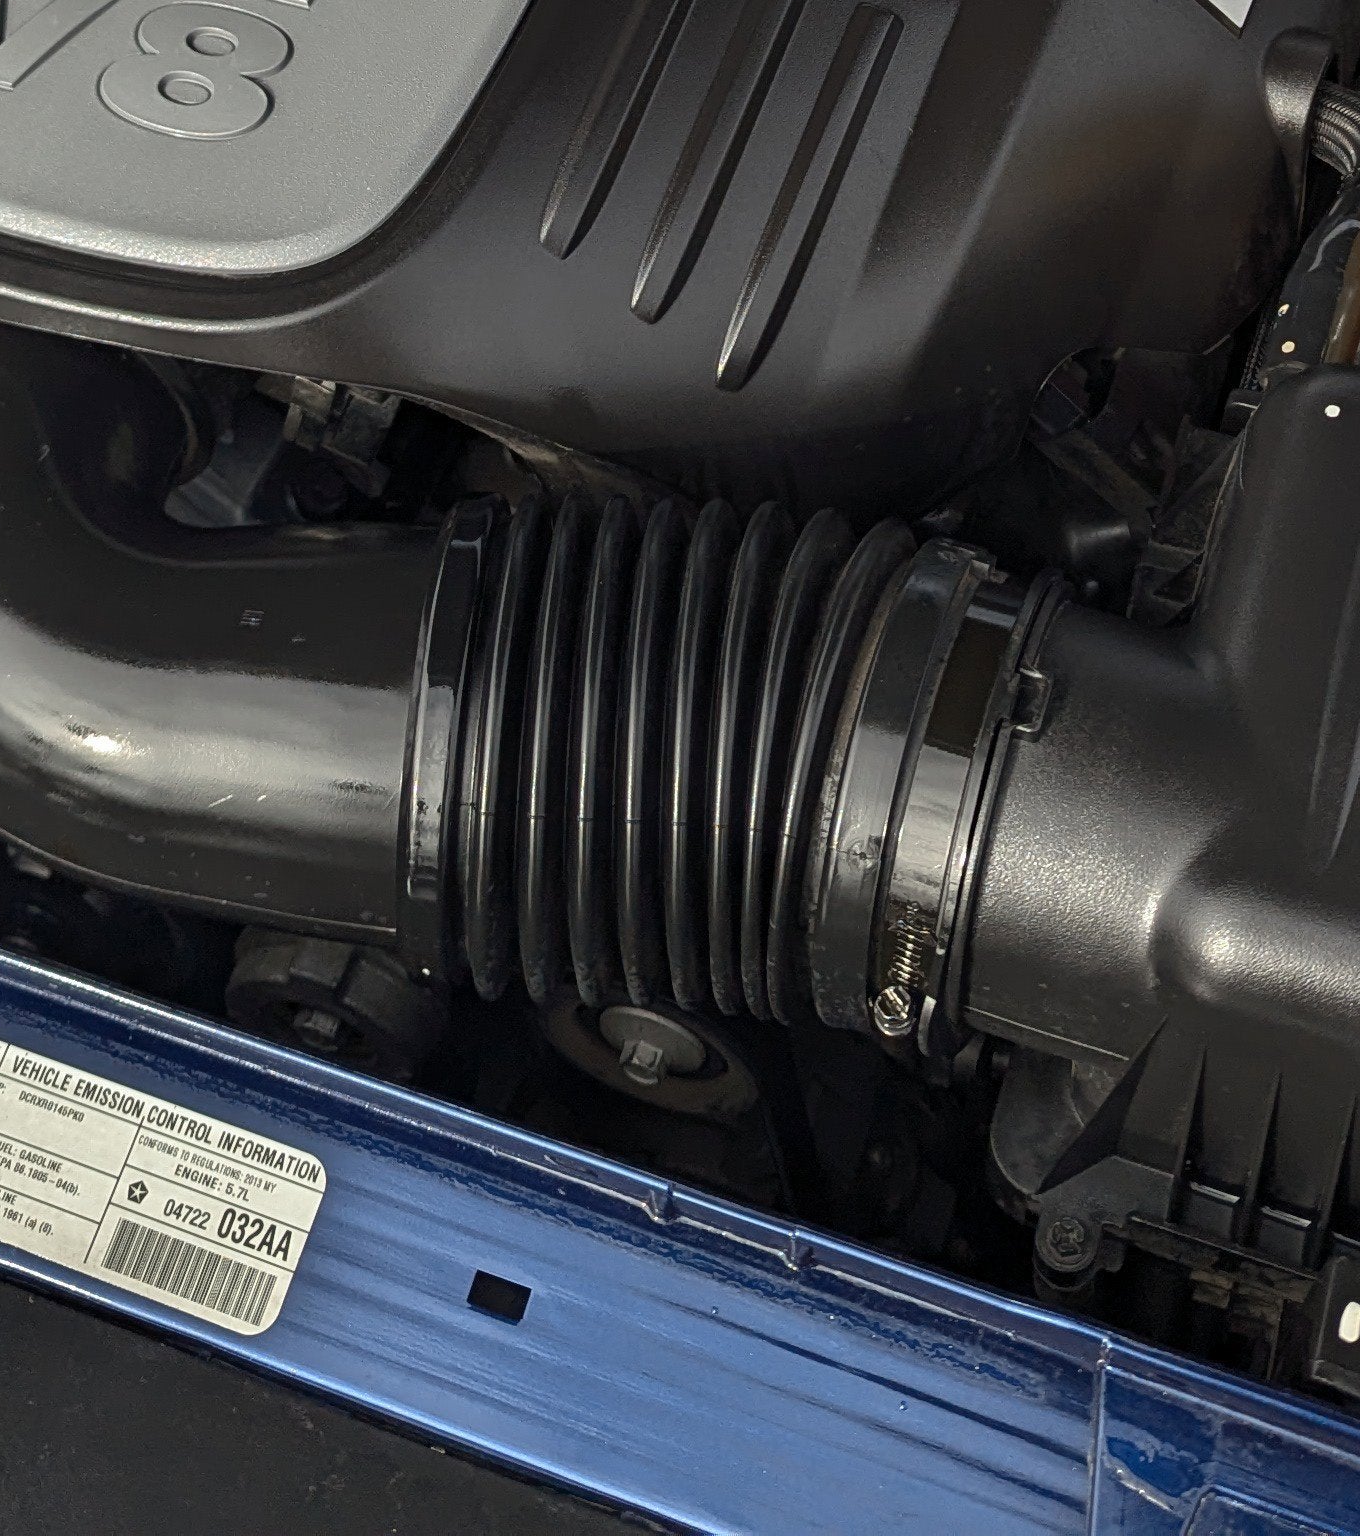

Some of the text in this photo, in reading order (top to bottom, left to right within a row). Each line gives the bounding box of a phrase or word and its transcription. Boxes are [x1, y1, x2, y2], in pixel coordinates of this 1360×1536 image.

[12, 1054, 321, 1183] VEHICLE EMISSION CONTROL INFORMATION
[18, 1148, 63, 1173] GASOLINE
[137, 1134, 277, 1193] CONFORMS TO REGULATIONS: 2013 MY
[173, 1163, 249, 1202] ENGINE: 5.7L
[162, 1198, 292, 1261] 04722 032AA
